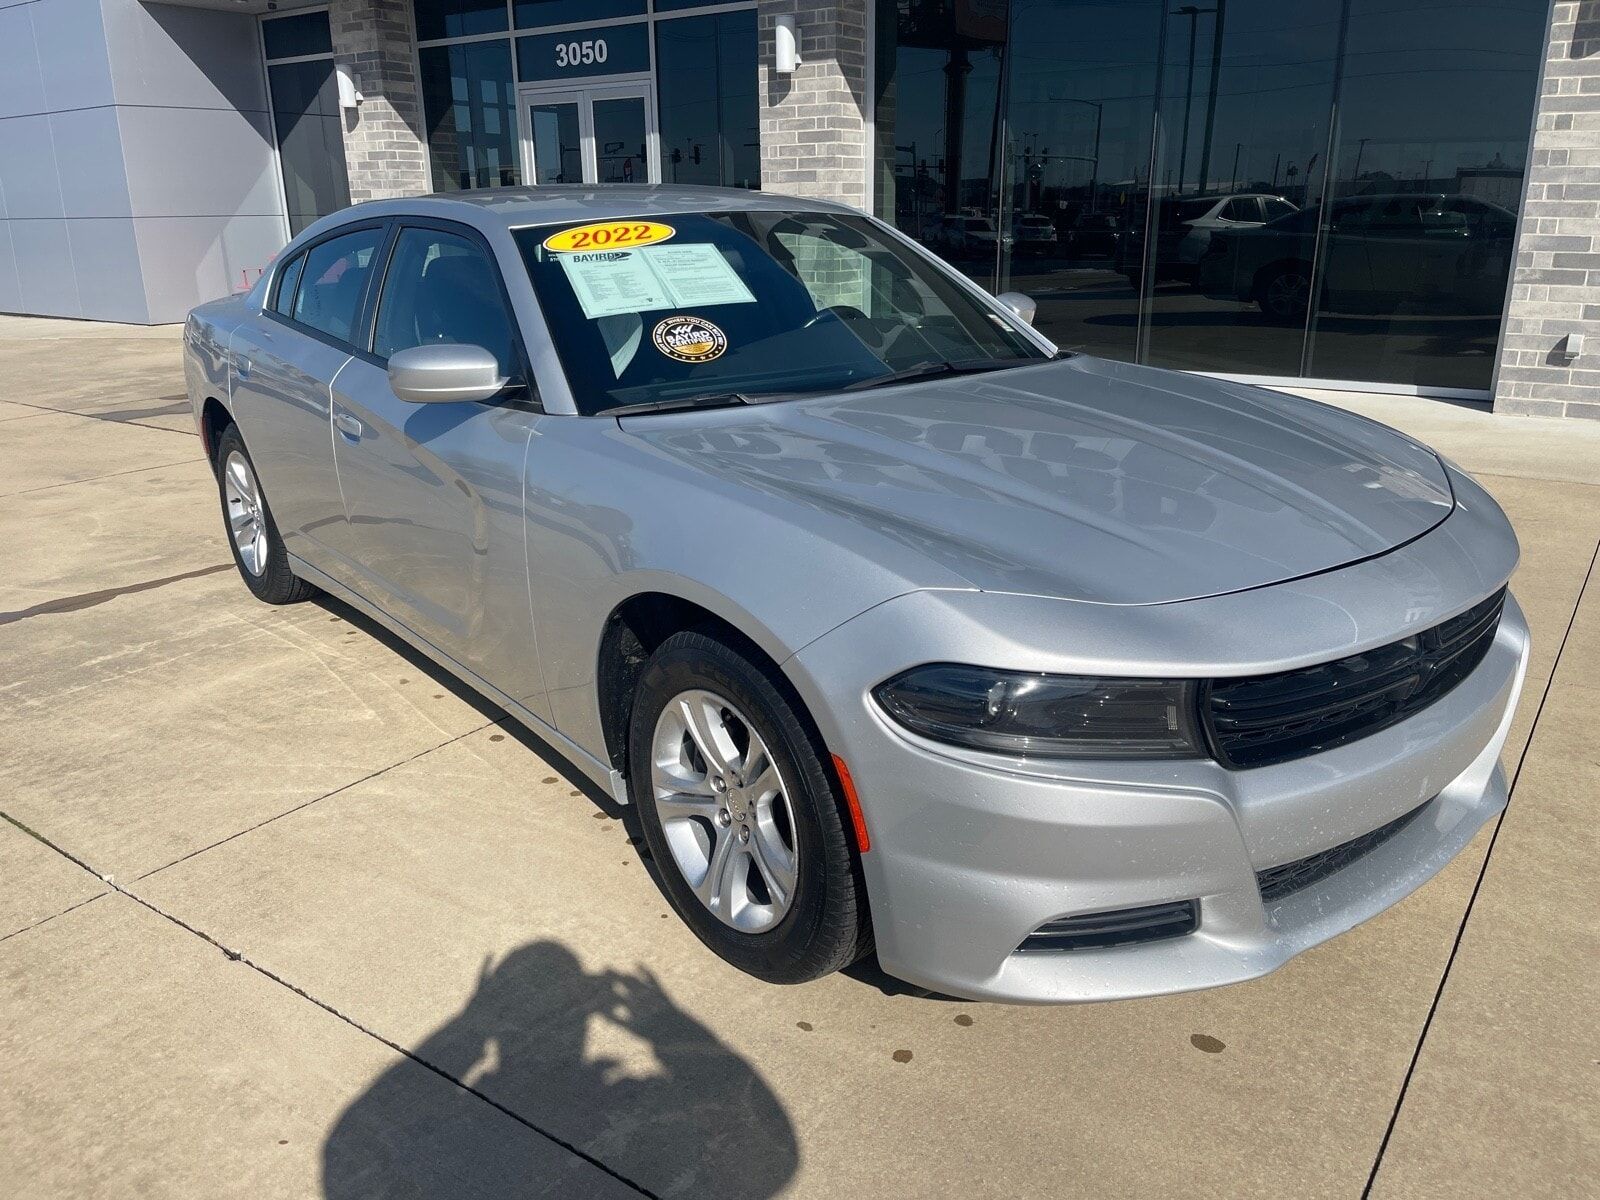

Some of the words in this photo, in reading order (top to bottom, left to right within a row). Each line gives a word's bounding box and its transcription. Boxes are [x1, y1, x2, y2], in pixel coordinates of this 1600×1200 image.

[555, 39, 607, 67] 3050
[571, 224, 652, 249] 2022
[573, 252, 615, 263] BAYIRD
[665, 330, 710, 343] BAYIRD
[670, 336, 714, 347] CERTIFIED
